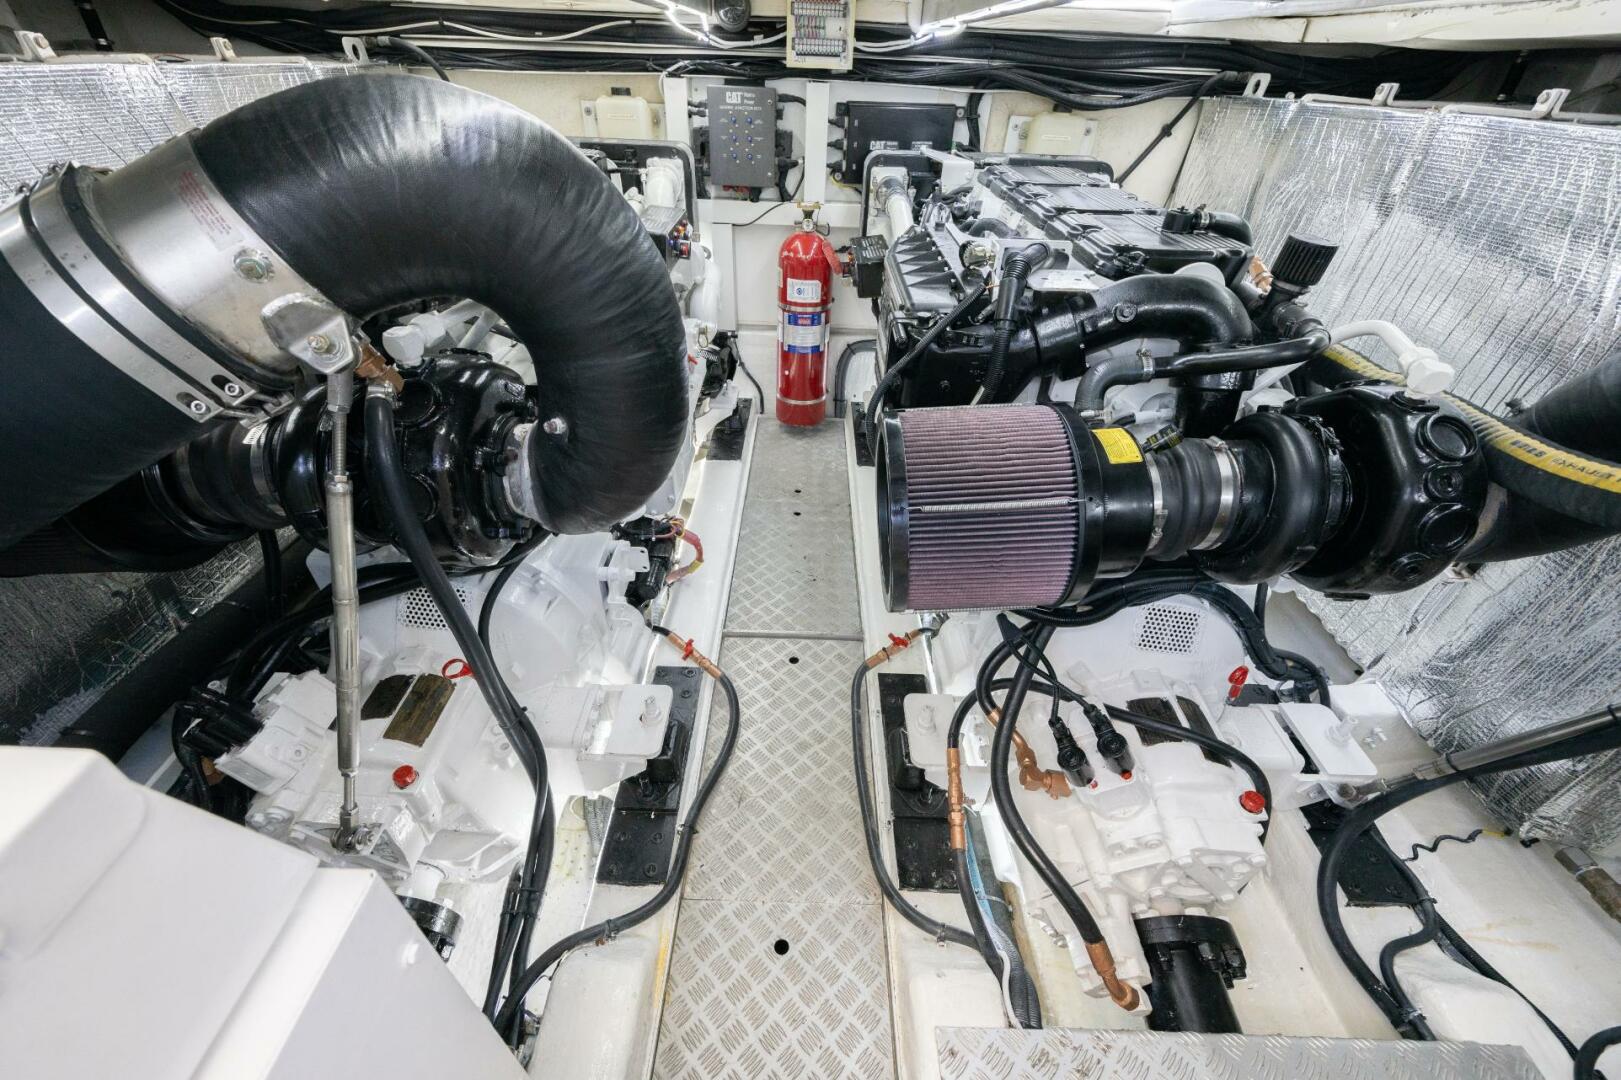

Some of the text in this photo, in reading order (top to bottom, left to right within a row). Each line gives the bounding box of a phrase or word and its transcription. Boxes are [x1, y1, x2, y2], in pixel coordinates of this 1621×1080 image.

[726, 91, 743, 104] CAT
[870, 140, 886, 150] CAT
[1551, 457, 1616, 480] EXHAUST
